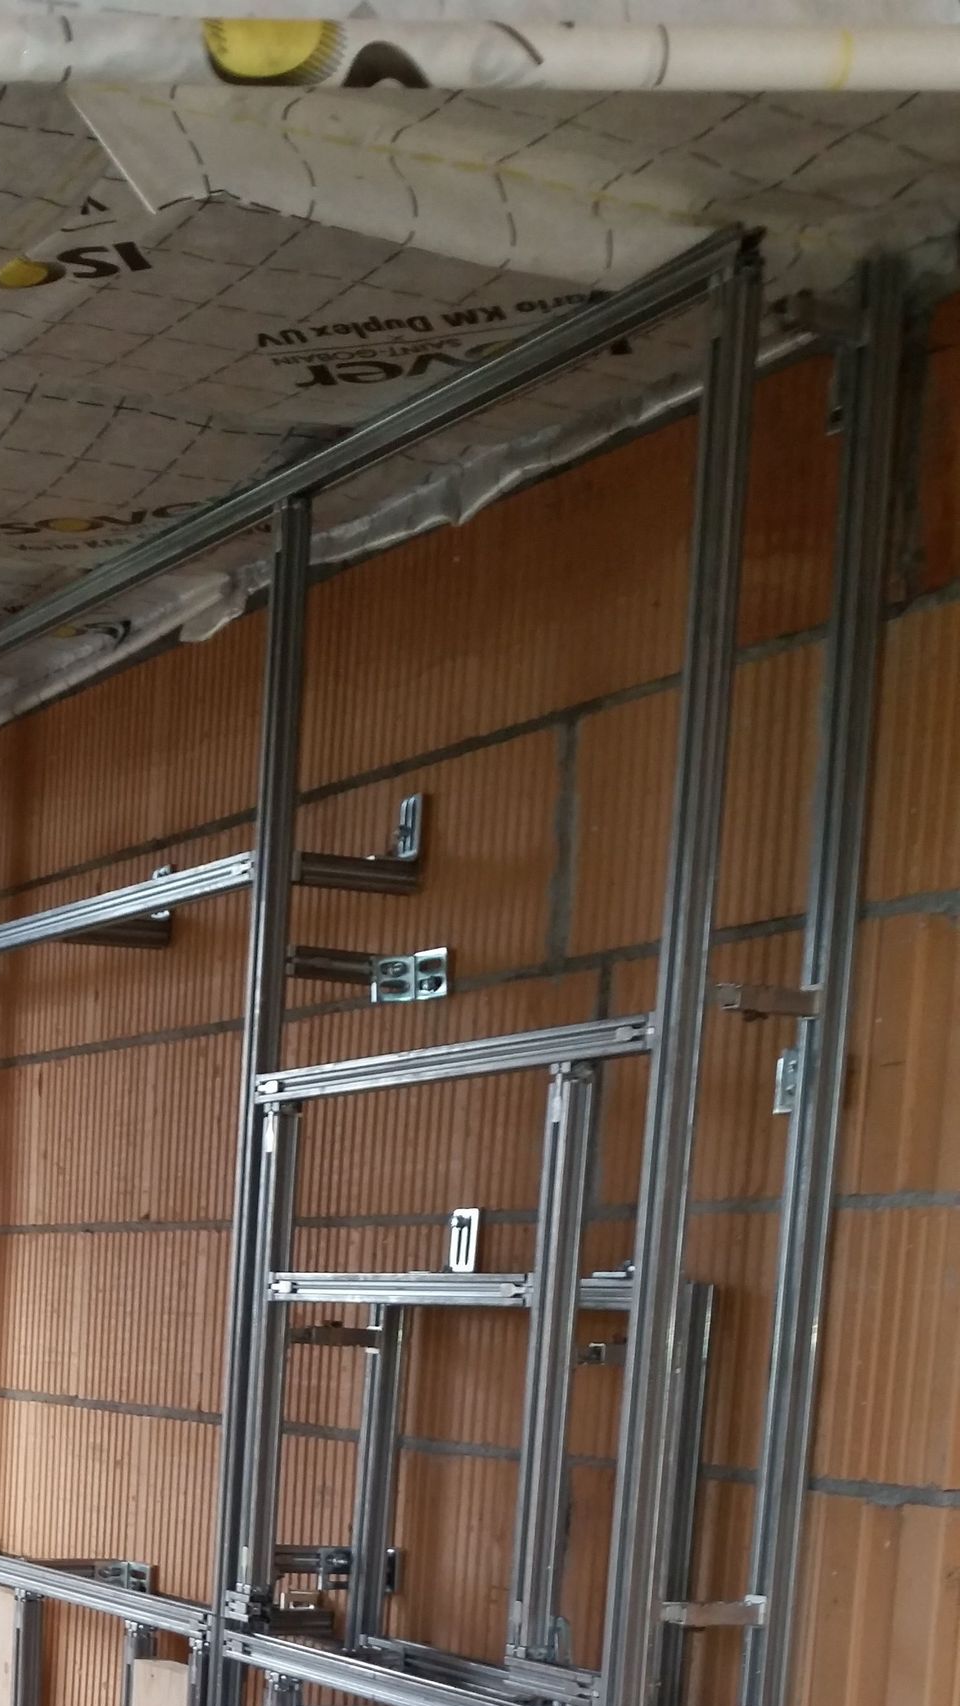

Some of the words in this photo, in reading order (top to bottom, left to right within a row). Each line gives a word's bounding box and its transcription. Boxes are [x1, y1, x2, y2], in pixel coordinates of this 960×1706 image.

[314, 315, 432, 339] Duplex
[443, 305, 507, 327] KM
[256, 329, 309, 348] UV
